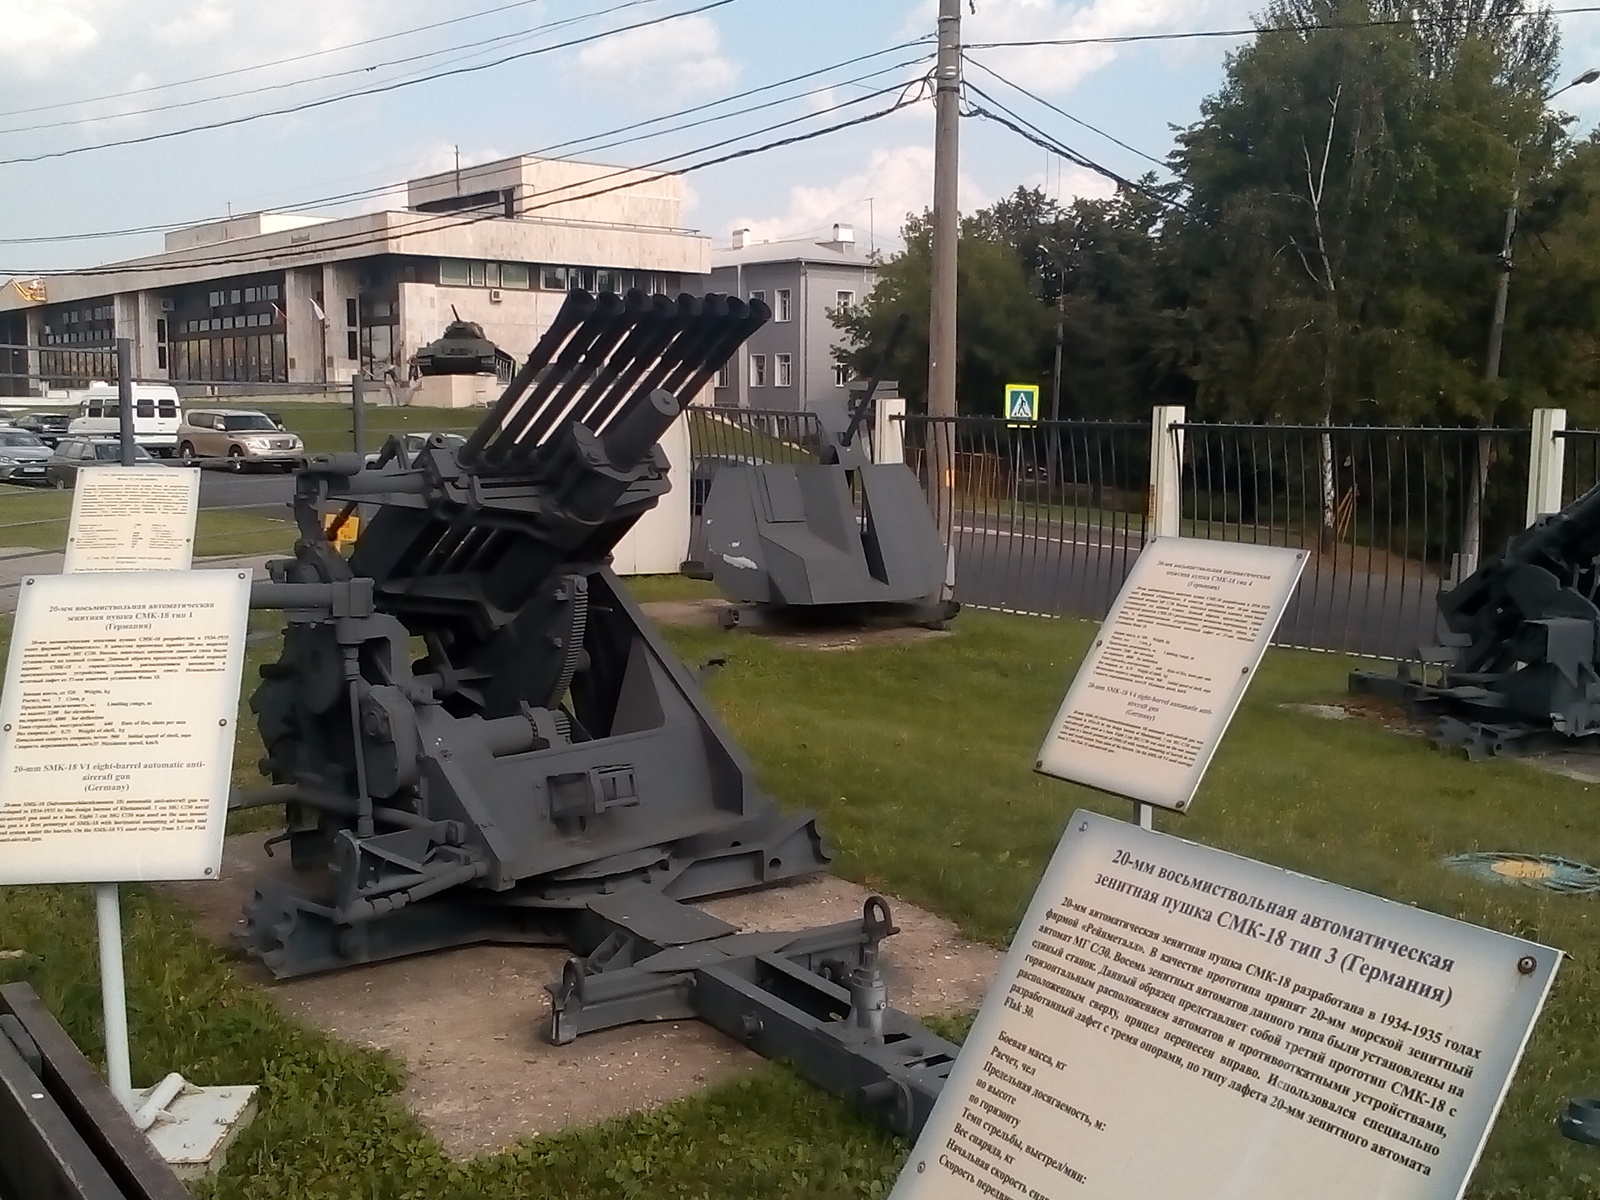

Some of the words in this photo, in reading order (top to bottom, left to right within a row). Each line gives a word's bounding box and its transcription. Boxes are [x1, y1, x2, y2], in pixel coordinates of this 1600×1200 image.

[1093, 873, 1160, 904] зенитная
[1160, 895, 1213, 922] пушка
[1216, 910, 1287, 947] СМК-18
[1289, 938, 1323, 960] тип
[1324, 947, 1338, 964] 3
[1340, 952, 1452, 1007] (Германия)
[1111, 849, 1156, 875] 20-мм
[1156, 866, 1298, 921] восьмиствольная
[1299, 912, 1455, 972] автоматическая
[1003, 995, 1022, 1012] Flak
[1021, 1004, 1034, 1018] 30.
[1038, 924, 1073, 943] автомат
[1072, 935, 1091, 949] МГ
[1112, 950, 1146, 972] Восемь
[1146, 966, 1195, 992] зенитных
[1195, 985, 1249, 1013] автоматов
[1248, 1006, 1298, 1031] данного
[1296, 1020, 1325, 1043] типа
[1326, 1034, 1361, 1057] были
[1359, 1049, 1446, 1090] установлены
[1446, 1083, 1465, 1098] на
[1045, 908, 1080, 928] фирмой
[1080, 922, 1145, 954] «Рейнметалл».
[1148, 946, 1159, 958] В
[1159, 953, 1204, 976] качестве
[1205, 970, 1265, 998] прототипа
[1263, 990, 1308, 1018] принят
[1309, 1007, 1346, 1030] 20-мм
[1349, 1024, 1404, 1052] морской
[1406, 1046, 1474, 1079] зенитный
[1060, 896, 1088, 914] 20-мм
[1088, 908, 1160, 940] автоматическая
[1160, 935, 1207, 958] зенитная
[1207, 952, 1243, 971] пушка
[1243, 963, 1292, 989] СМК-18
[1290, 982, 1365, 1016] разработана
[1367, 1010, 1376, 1020] в
[1378, 1012, 1443, 1048] 1934-1935
[1443, 1038, 1482, 1059] годах
[990, 1045, 1019, 1070] Расчет,
[1021, 1062, 1036, 1076] чел
[997, 1030, 1028, 1052] Боевая
[1026, 1046, 1053, 1068] масса,
[1054, 1060, 1068, 1071] кг
[1016, 968, 1086, 1004] расположенным
[1088, 999, 1120, 1021] сверху,
[1123, 1014, 1160, 1036] прицел
[1162, 1031, 1216, 1059] перенесен
[1219, 1054, 1260, 1080] вправо.
[1266, 1072, 1357, 1121] Использовался
[1362, 1116, 1440, 1156] специально
[1024, 954, 1096, 989] горизонтальным
[1095, 984, 1170, 1020] расположением
[1171, 1015, 1224, 1043] автоматов
[1226, 1037, 1236, 1048] и
[1237, 1042, 1351, 1096] противооткатными
[1351, 1090, 1447, 1139] устройствами,
[1031, 939, 1065, 958] единый
[1064, 952, 1096, 972] станок.
[1096, 963, 1138, 988] Данный
[1138, 982, 1176, 1005] образец
[1177, 998, 1249, 1032] представляет
[1249, 1027, 1283, 1046] собой
[1284, 1040, 1327, 1064] третий
[1327, 1058, 1388, 1089] прототип
[1390, 1081, 1446, 1112] СМК-18
[1448, 1107, 1457, 1117] с
[968, 1093, 980, 1105] по
[978, 1099, 1021, 1129] горизонту
[975, 1078, 987, 1089] по
[986, 1084, 1017, 1105] высоте
[982, 1060, 1032, 1094] Предельная
[1030, 1088, 1092, 1127] досягаемость,
[1093, 1119, 1106, 1131] м:
[1008, 983, 1076, 1017] разработанный
[1074, 1012, 1103, 1030] лафет
[1102, 1024, 1110, 1033] с
[1110, 1026, 1139, 1046] тремя
[1139, 1040, 1184, 1069] опорами,
[1185, 1060, 1200, 1073] по
[1201, 1067, 1228, 1087] типу
[1227, 1079, 1268, 1104] лафета
[1269, 1095, 1306, 1120] 20-мм
[1306, 1113, 1369, 1148] зенитного
[1370, 1142, 1431, 1176] автомата
[938, 1153, 975, 1184] Скорость
[945, 1137, 990, 1171] Начальная
[990, 1166, 1027, 1194] скорость
[953, 1122, 969, 1138] Вес
[968, 1133, 1002, 1160] снаряда,
[1003, 1153, 1016, 1165] кг
[961, 1106, 983, 1127] Темп
[982, 1121, 1023, 1152] стрельбы,
[1024, 1144, 1087, 1184] выстрел/мин:
